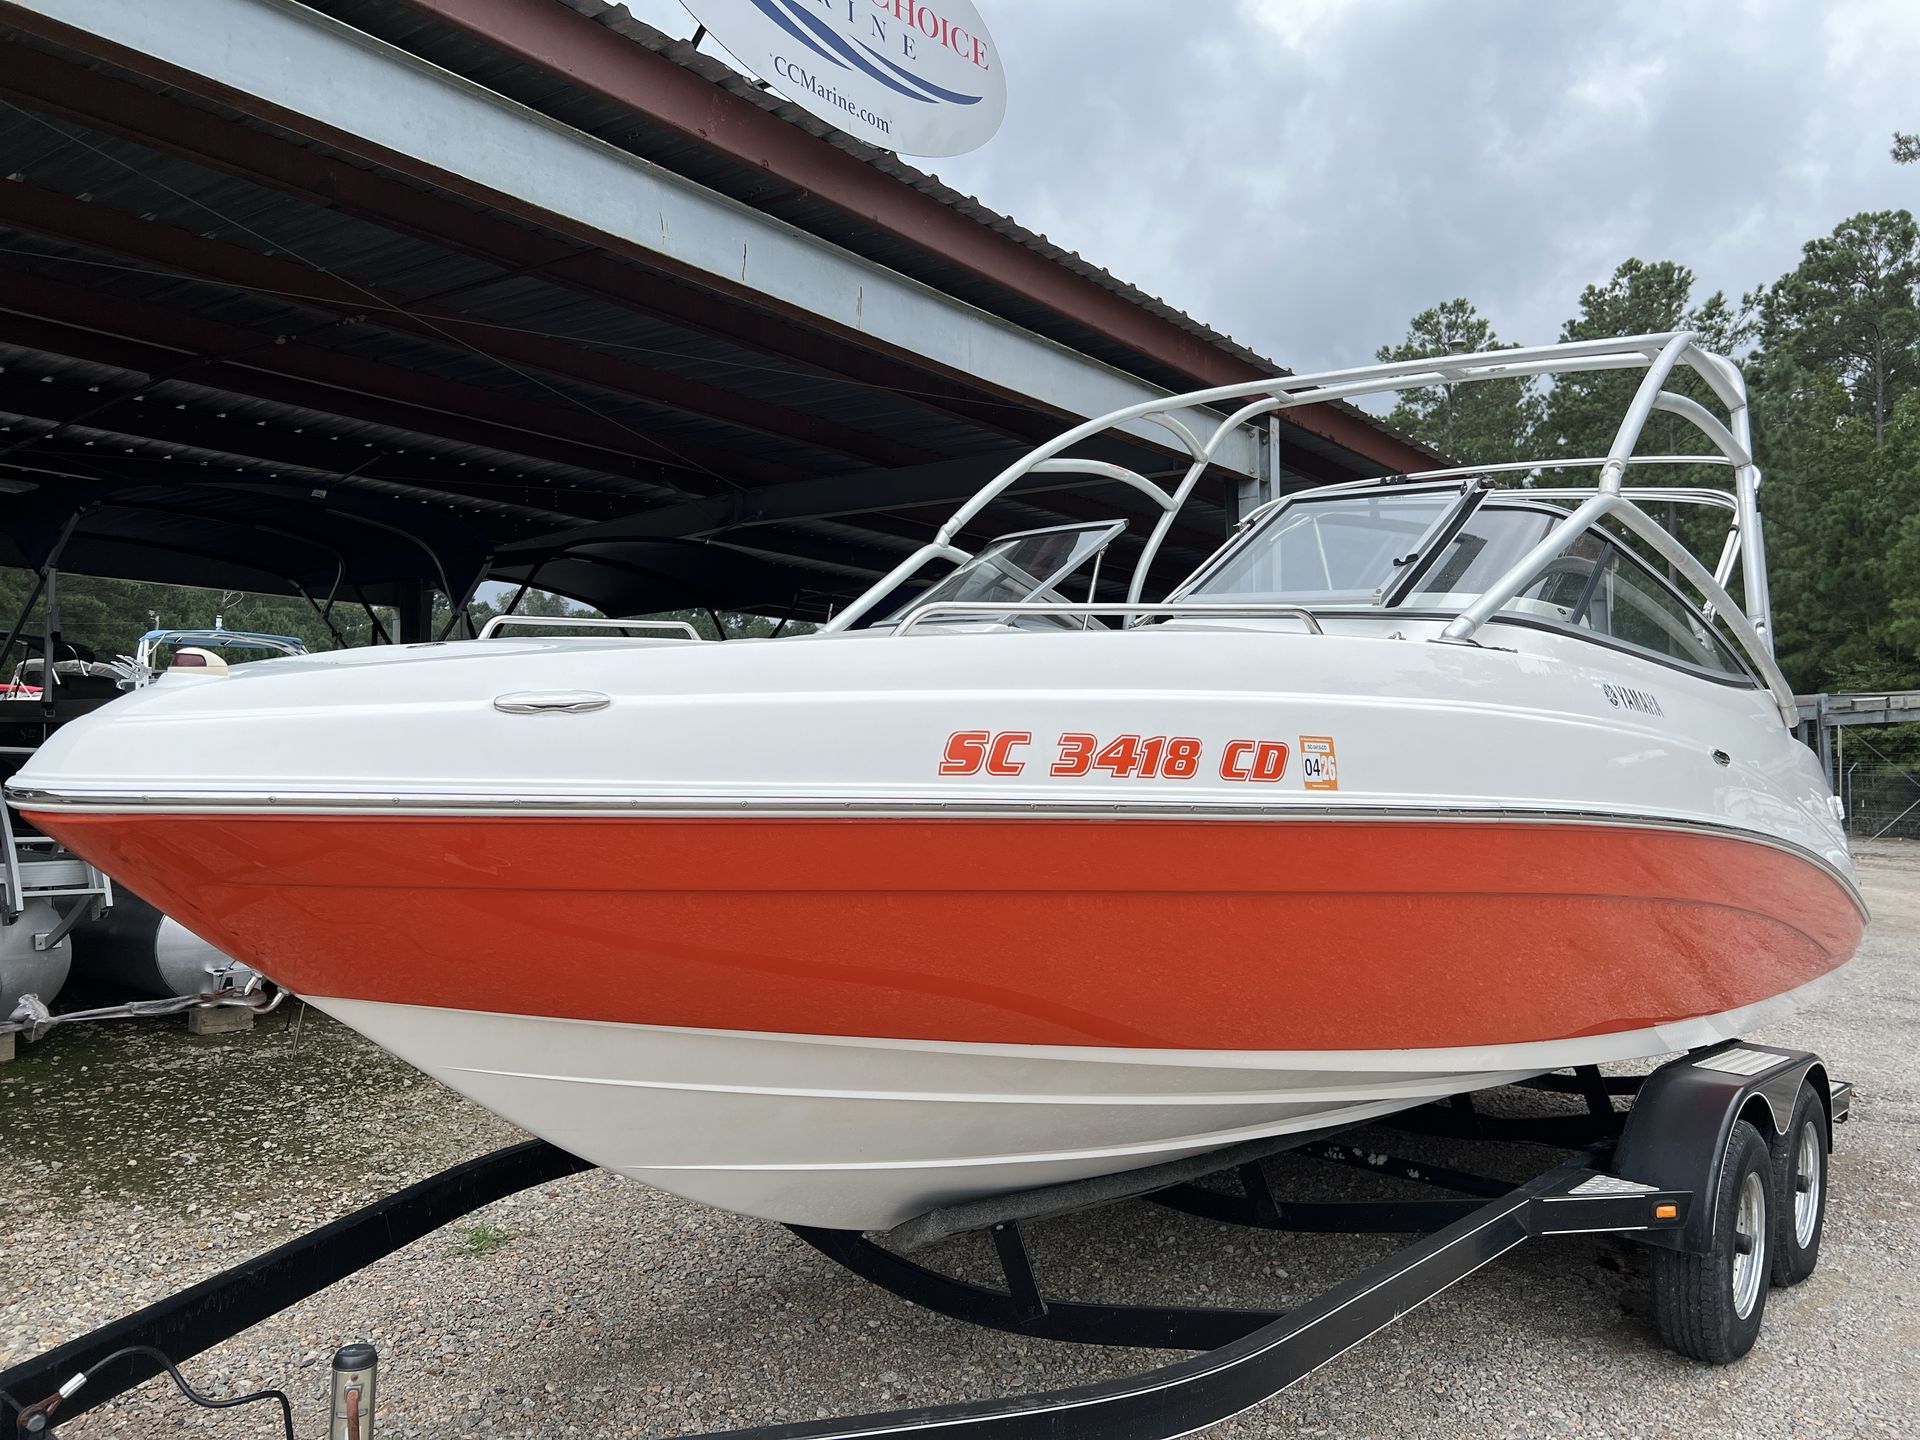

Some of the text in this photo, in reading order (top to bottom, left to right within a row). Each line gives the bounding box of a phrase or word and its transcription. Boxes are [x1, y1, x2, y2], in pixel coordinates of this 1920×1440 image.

[774, 56, 890, 135] CCMarine.com
[1613, 685, 1664, 718] YAMAHA
[938, 730, 1291, 783] SC 3418 CD
